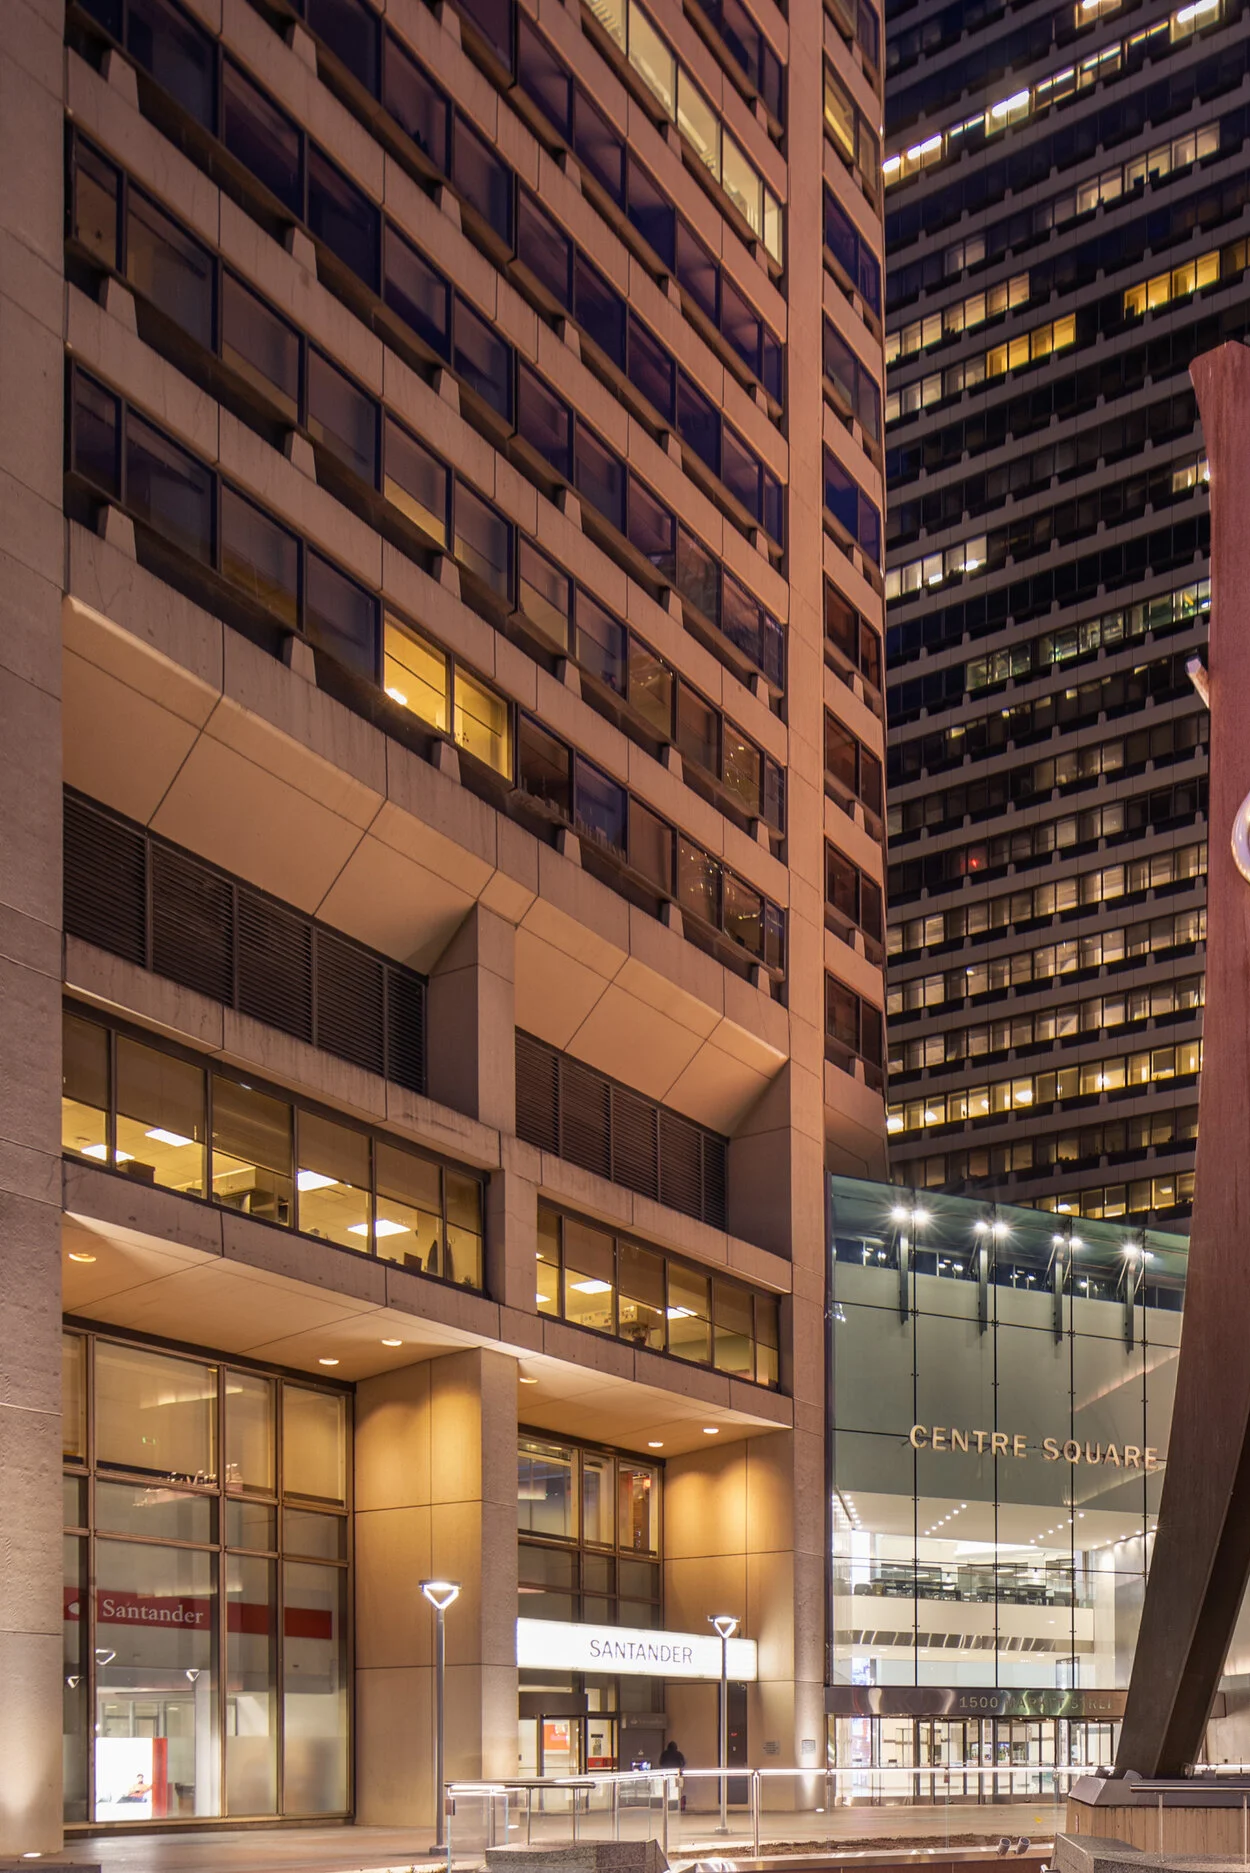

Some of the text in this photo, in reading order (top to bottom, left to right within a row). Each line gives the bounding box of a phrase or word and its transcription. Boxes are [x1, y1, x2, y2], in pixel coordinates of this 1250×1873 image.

[909, 1424, 1160, 1470] CENTRE SQUARE
[102, 1598, 204, 1624] Santander
[590, 1639, 693, 1664] SANTANDER
[959, 1696, 999, 1709] 1500
